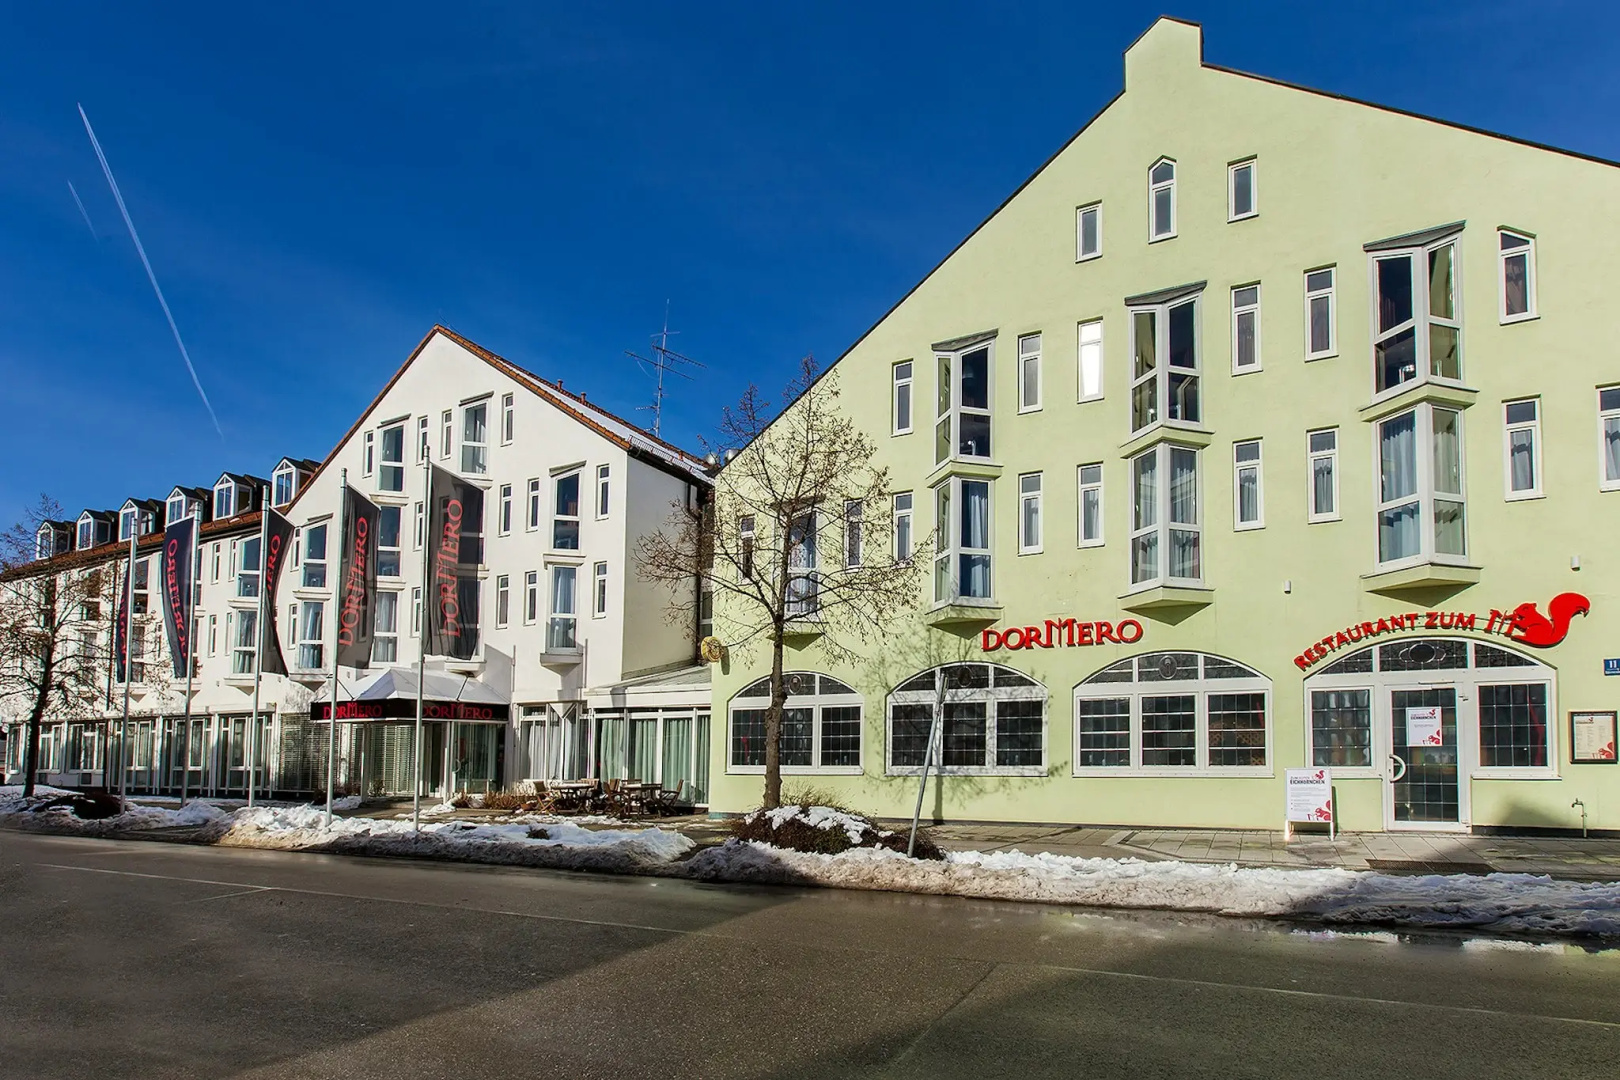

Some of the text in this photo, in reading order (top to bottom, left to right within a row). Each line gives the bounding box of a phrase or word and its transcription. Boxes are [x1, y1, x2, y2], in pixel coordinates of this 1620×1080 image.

[338, 516, 368, 647] DORMERO
[436, 499, 463, 638] DORMERO
[981, 617, 1144, 652] DORMERO
[1293, 612, 1419, 672] RESTAURANT
[1425, 611, 1476, 631] ZUM
[1608, 660, 1617, 669] 11
